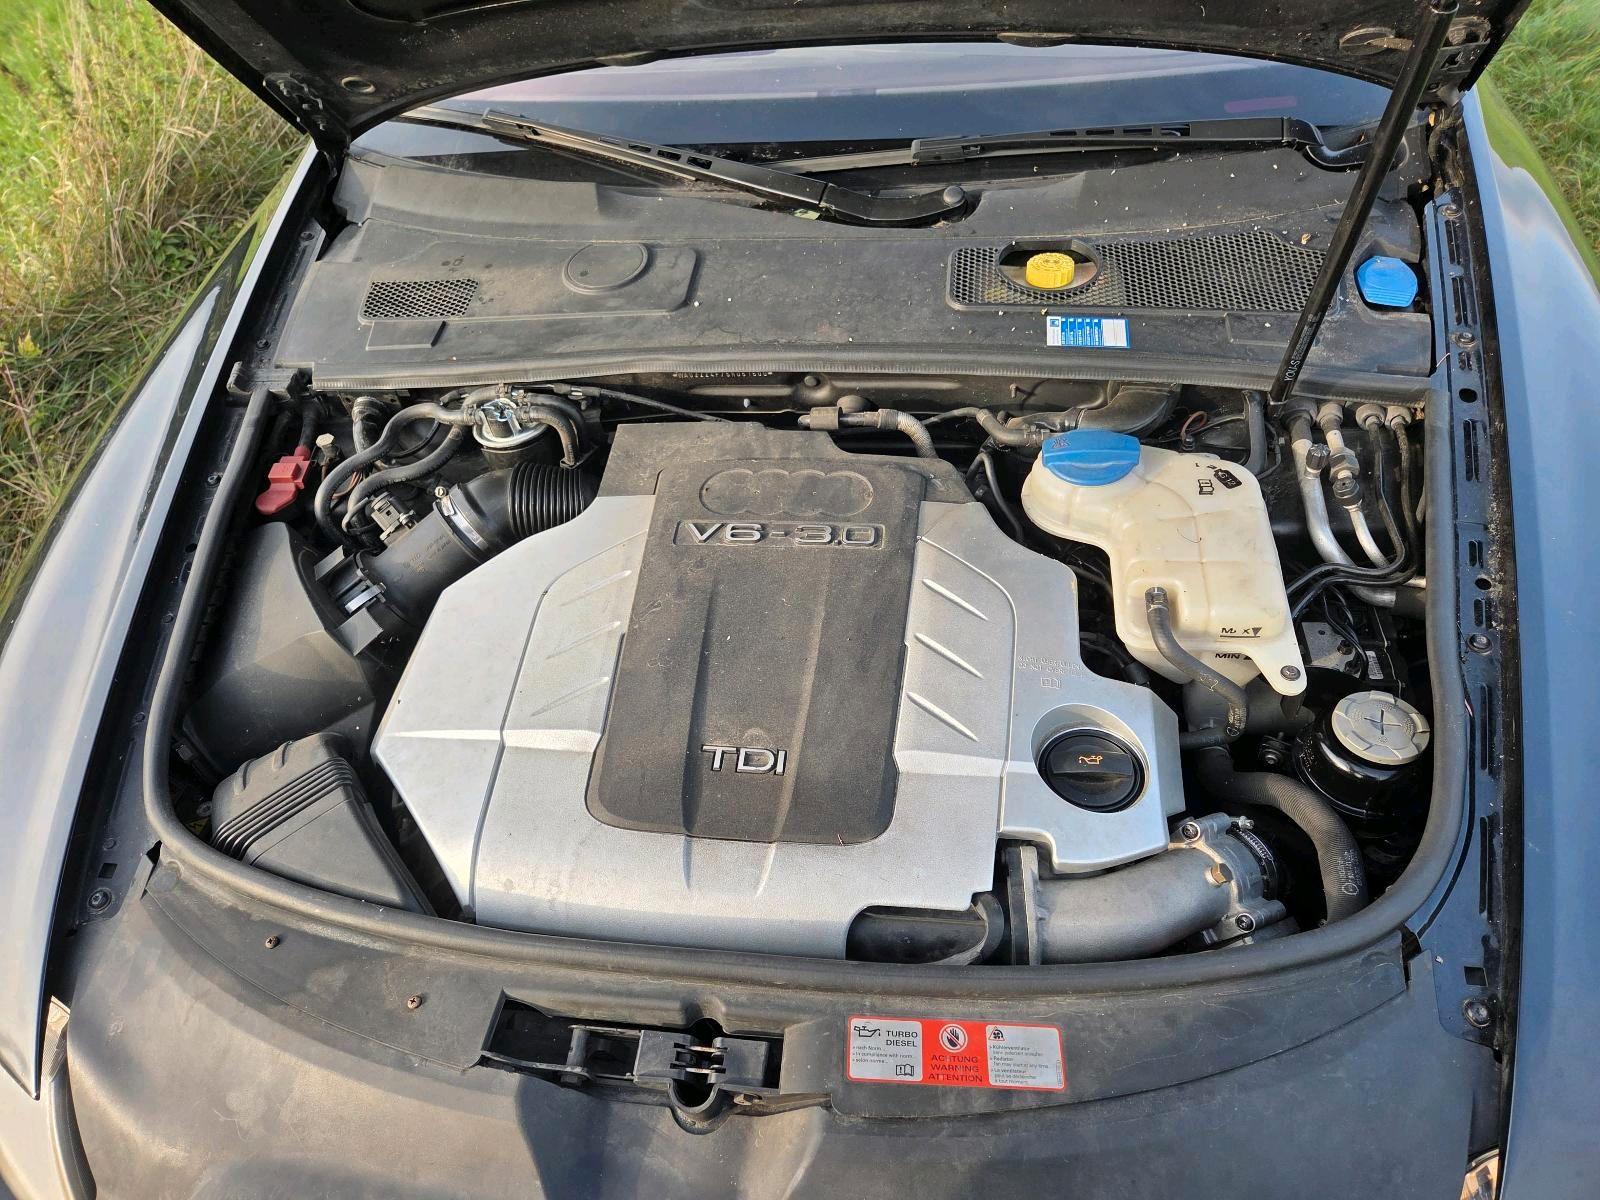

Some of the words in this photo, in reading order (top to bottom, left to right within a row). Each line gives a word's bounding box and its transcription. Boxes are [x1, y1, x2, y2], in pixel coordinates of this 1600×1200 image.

[1221, 627, 1251, 635] MX
[702, 744, 788, 776] TDI
[886, 1030, 918, 1039] TURBO
[885, 1039, 918, 1048] DIESEL
[931, 1054, 978, 1064] ACHTUNG
[930, 1063, 979, 1073] WARNING
[928, 1073, 983, 1083] ATTENTION
